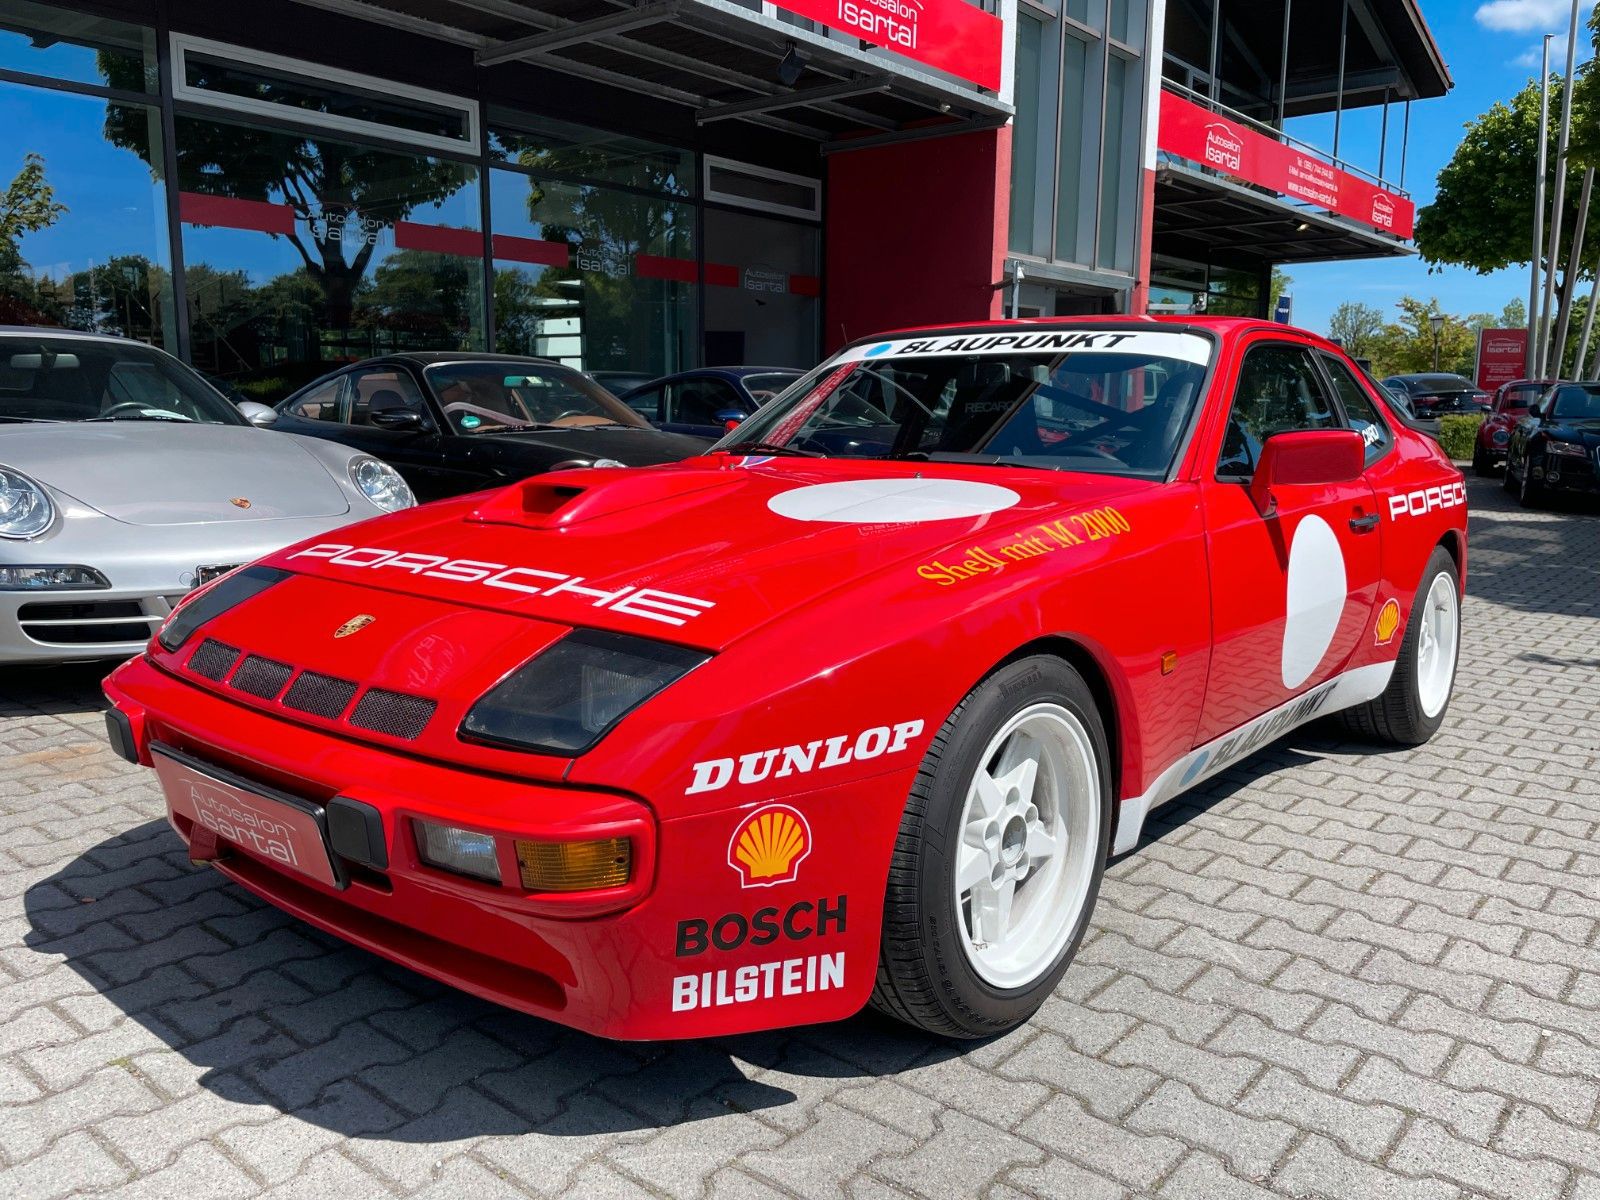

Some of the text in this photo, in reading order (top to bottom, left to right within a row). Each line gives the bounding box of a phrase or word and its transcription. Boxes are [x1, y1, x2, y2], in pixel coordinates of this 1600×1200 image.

[837, 0, 918, 50] Isartal
[864, 0, 918, 23] salon
[1205, 141, 1241, 171] Isartal
[1207, 130, 1241, 153] Autosalon
[306, 211, 385, 229] Autoalon
[1372, 207, 1394, 228] Isartal
[894, 334, 1137, 355] BLAUPUNKT
[1362, 423, 1380, 448] CARO
[1387, 480, 1468, 522] PORSCH
[916, 505, 1132, 587] Shell mit M 2000
[285, 543, 717, 627] PORSCHE
[1202, 681, 1340, 774] BLAUPUNKT
[684, 719, 925, 796] DUNLOP
[190, 785, 288, 836] Autosalon
[192, 799, 298, 866] Isartal
[675, 894, 848, 958] BOSCH
[672, 951, 846, 1013] BILSTEIN
